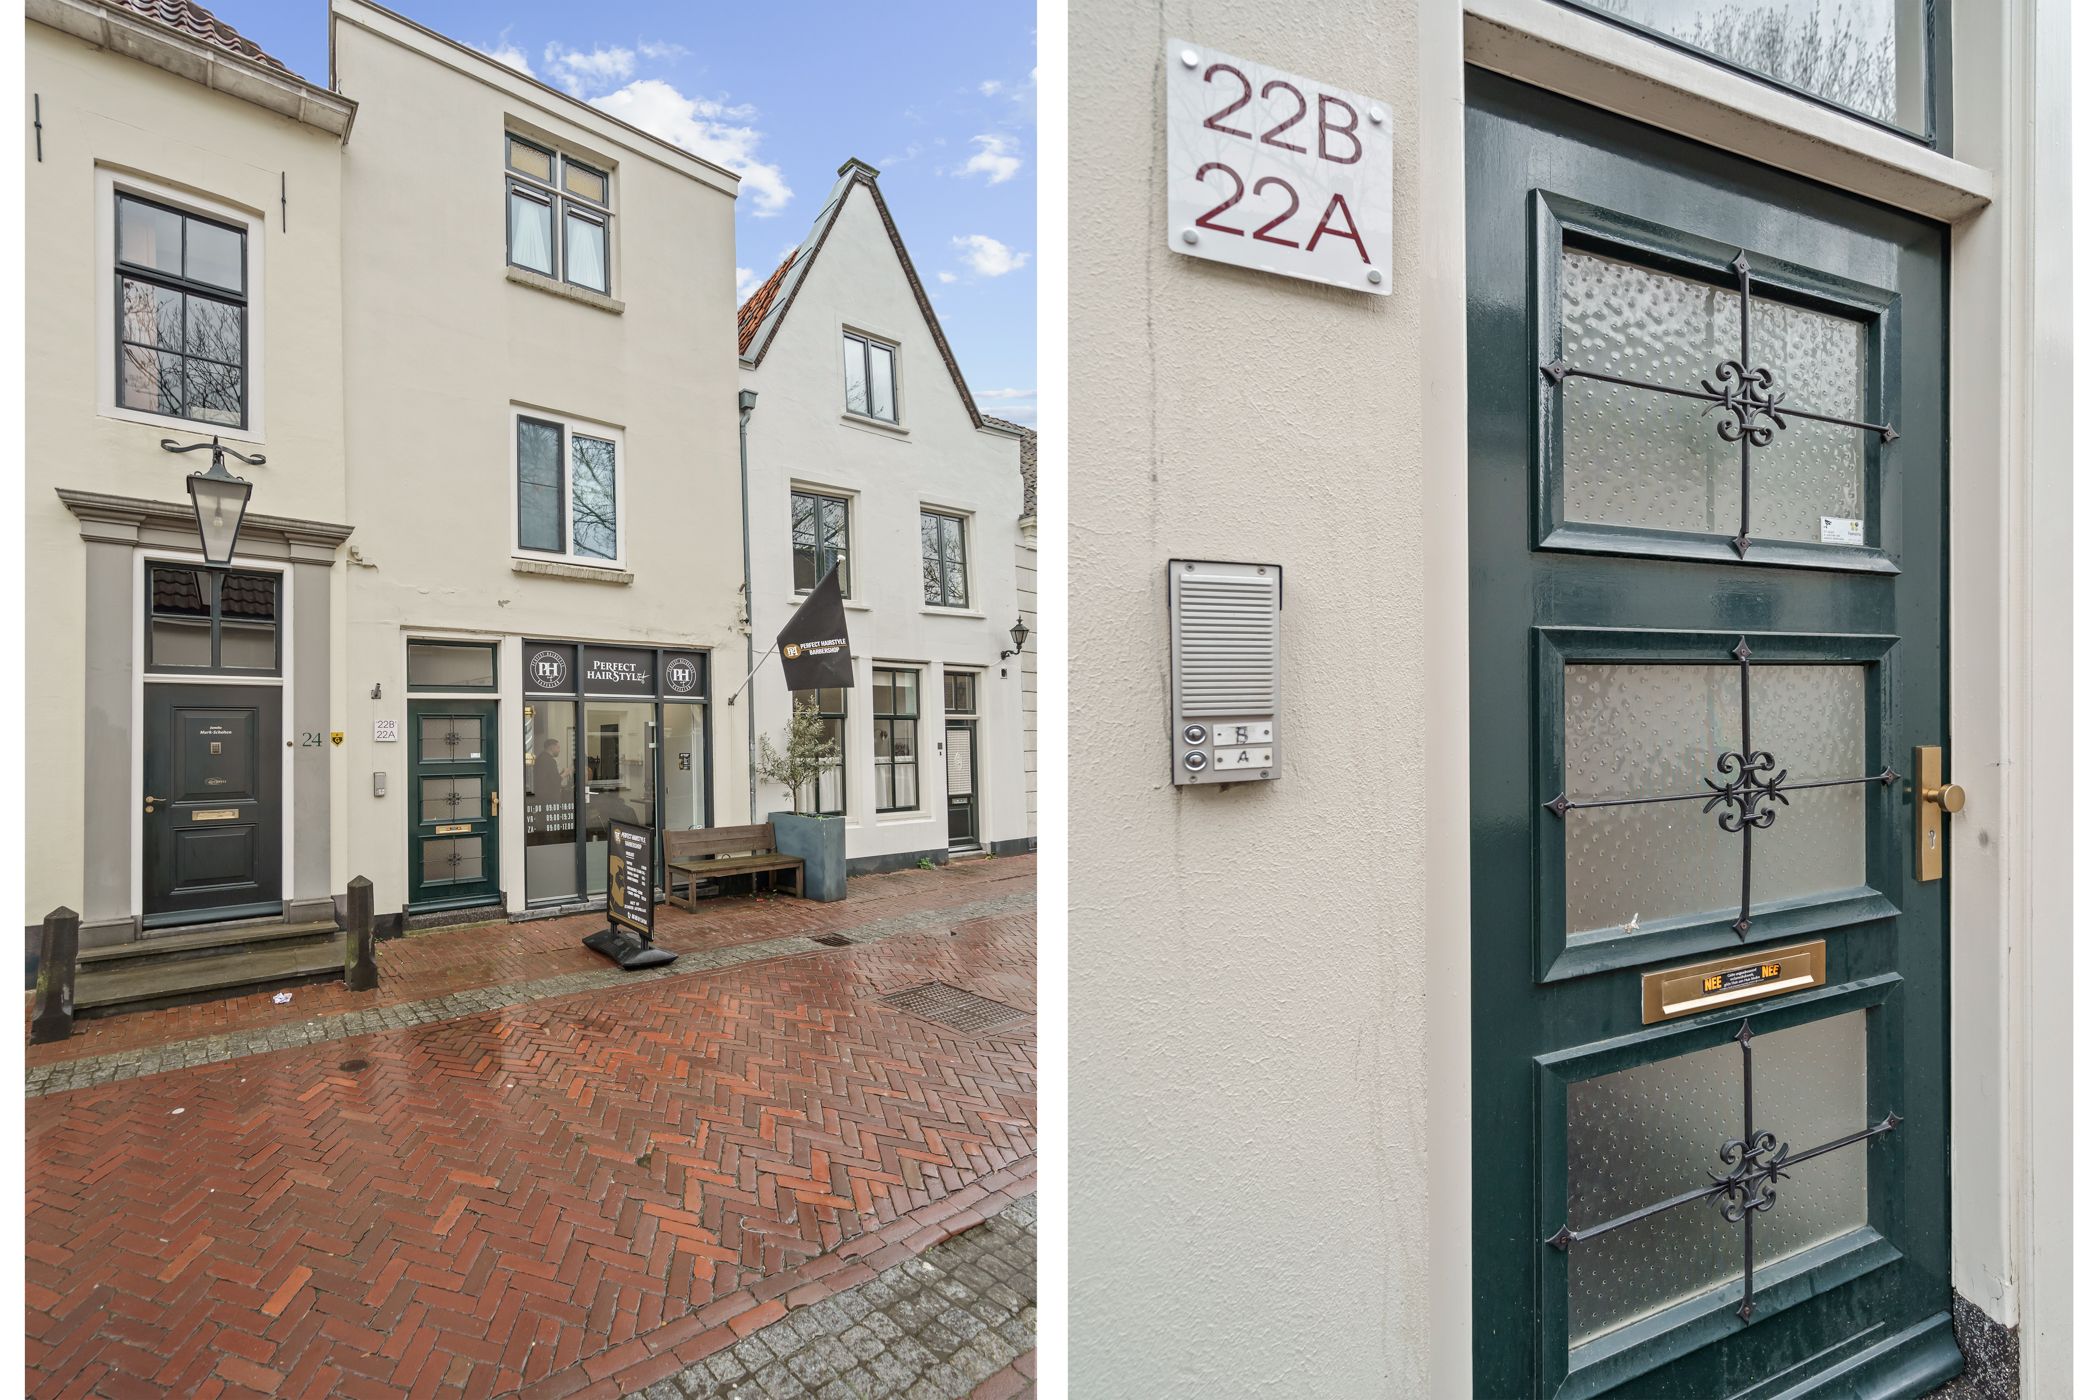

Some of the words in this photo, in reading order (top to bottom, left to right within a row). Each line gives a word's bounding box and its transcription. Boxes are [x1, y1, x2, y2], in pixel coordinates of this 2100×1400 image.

[1203, 63, 1363, 165] 22B
[1195, 162, 1371, 264] 22A
[538, 662, 558, 676] PH
[593, 660, 636, 672] PERFECT
[673, 669, 690, 681] PH
[302, 732, 322, 747] 24
[376, 730, 395, 738] 22A
[1235, 726, 1249, 744] B
[1237, 750, 1249, 763] A
[1761, 965, 1780, 978] NEE
[1704, 975, 1722, 991] NEE
